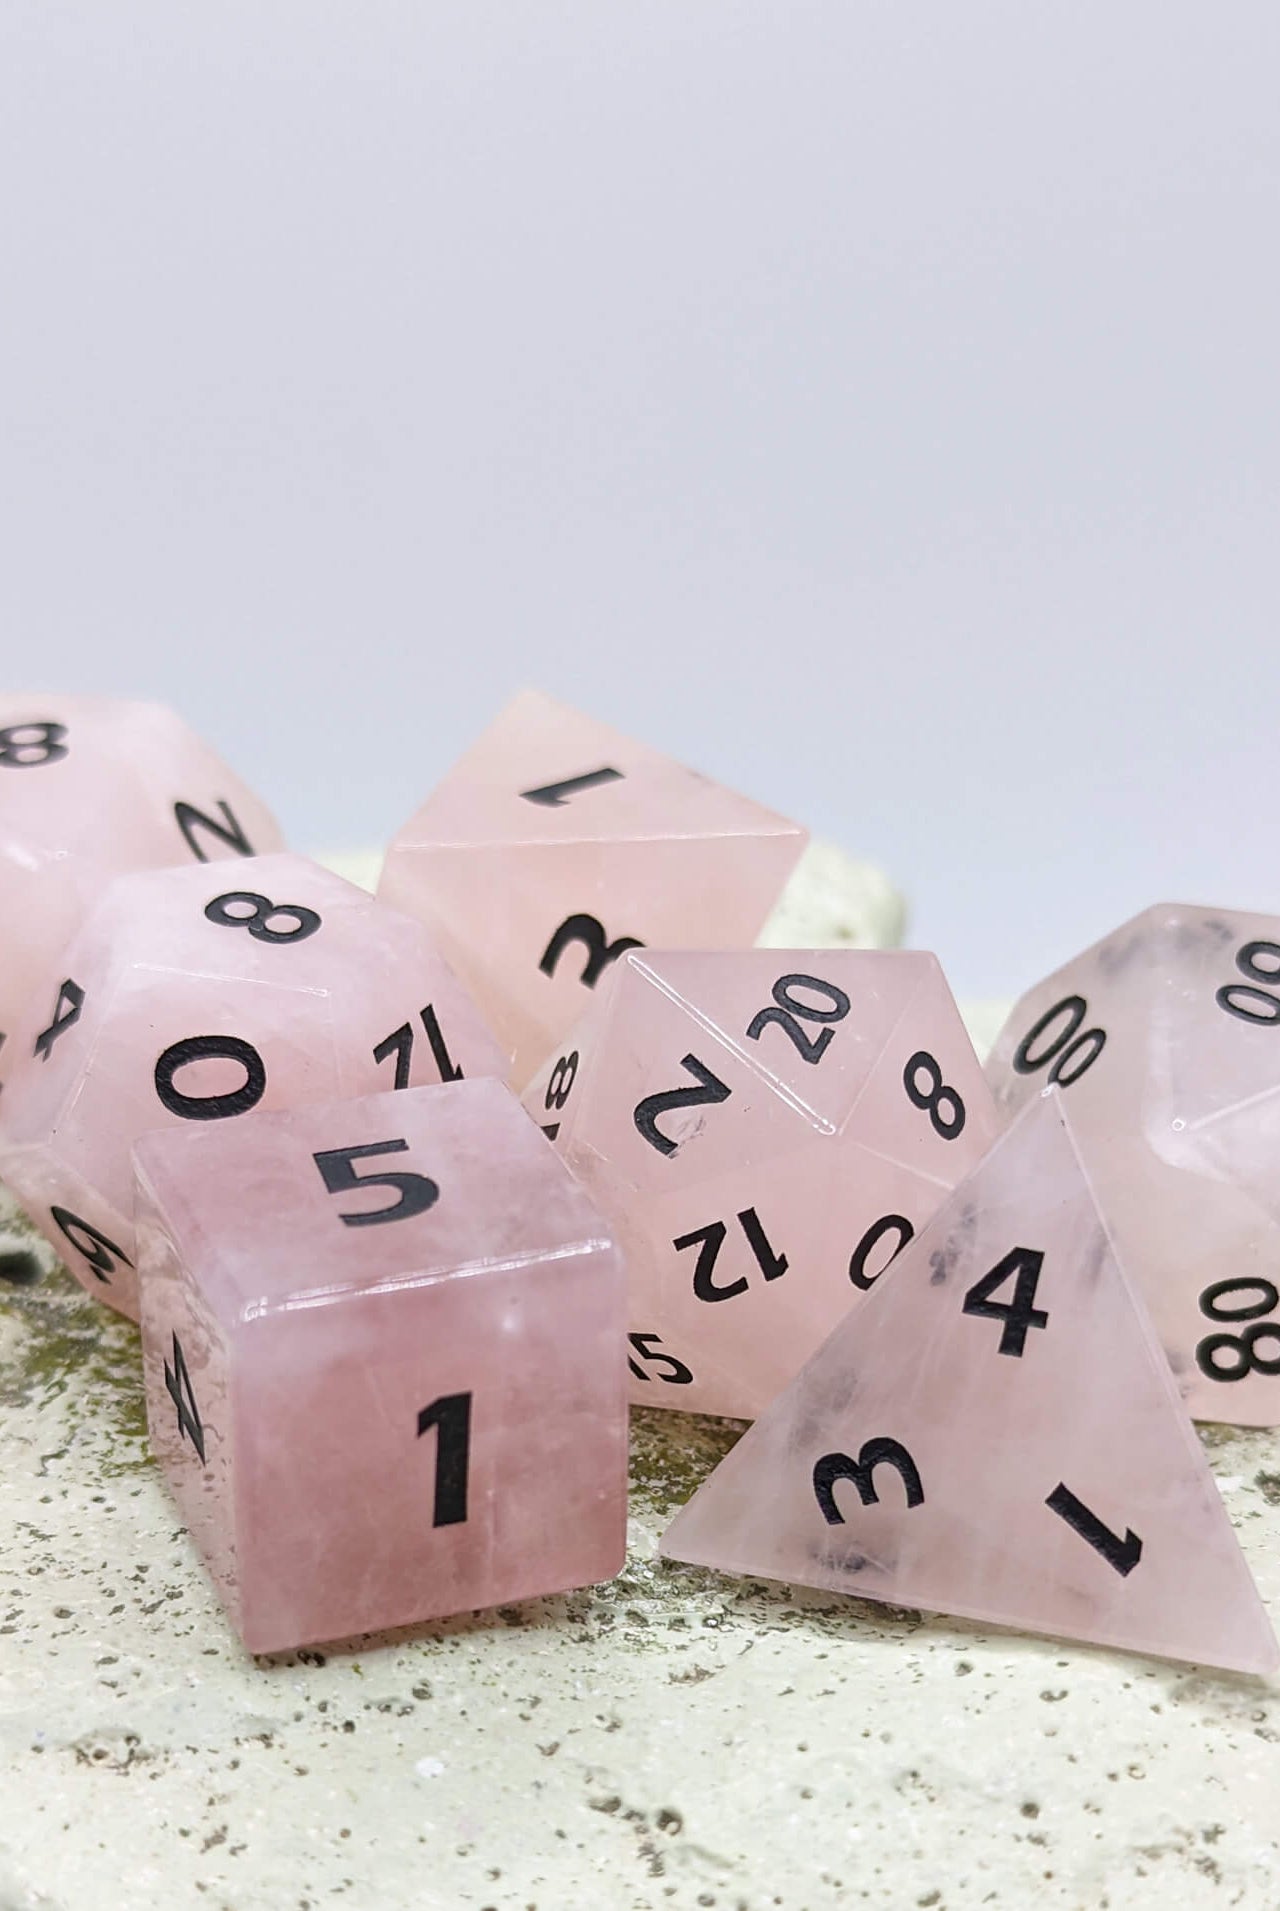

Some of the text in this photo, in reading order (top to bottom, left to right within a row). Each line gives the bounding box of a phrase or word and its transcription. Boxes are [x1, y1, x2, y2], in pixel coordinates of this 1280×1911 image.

[0, 722, 69, 768] 8
[520, 767, 625, 807] 1
[204, 891, 322, 944] 8
[539, 913, 646, 988] 3
[34, 978, 85, 1062] 4
[746, 973, 851, 1065] 20
[1013, 994, 1107, 1088] 00
[633, 1053, 732, 1159] 2
[903, 1050, 966, 1141] 8
[312, 1138, 440, 1227] 5
[672, 1207, 790, 1303] 12
[961, 1246, 1049, 1358] 4
[1196, 1277, 1280, 1383] 80
[163, 1328, 206, 1467] 4
[415, 1390, 473, 1529] 1
[812, 1436, 925, 1526] 3
[1044, 1481, 1144, 1578] 1
